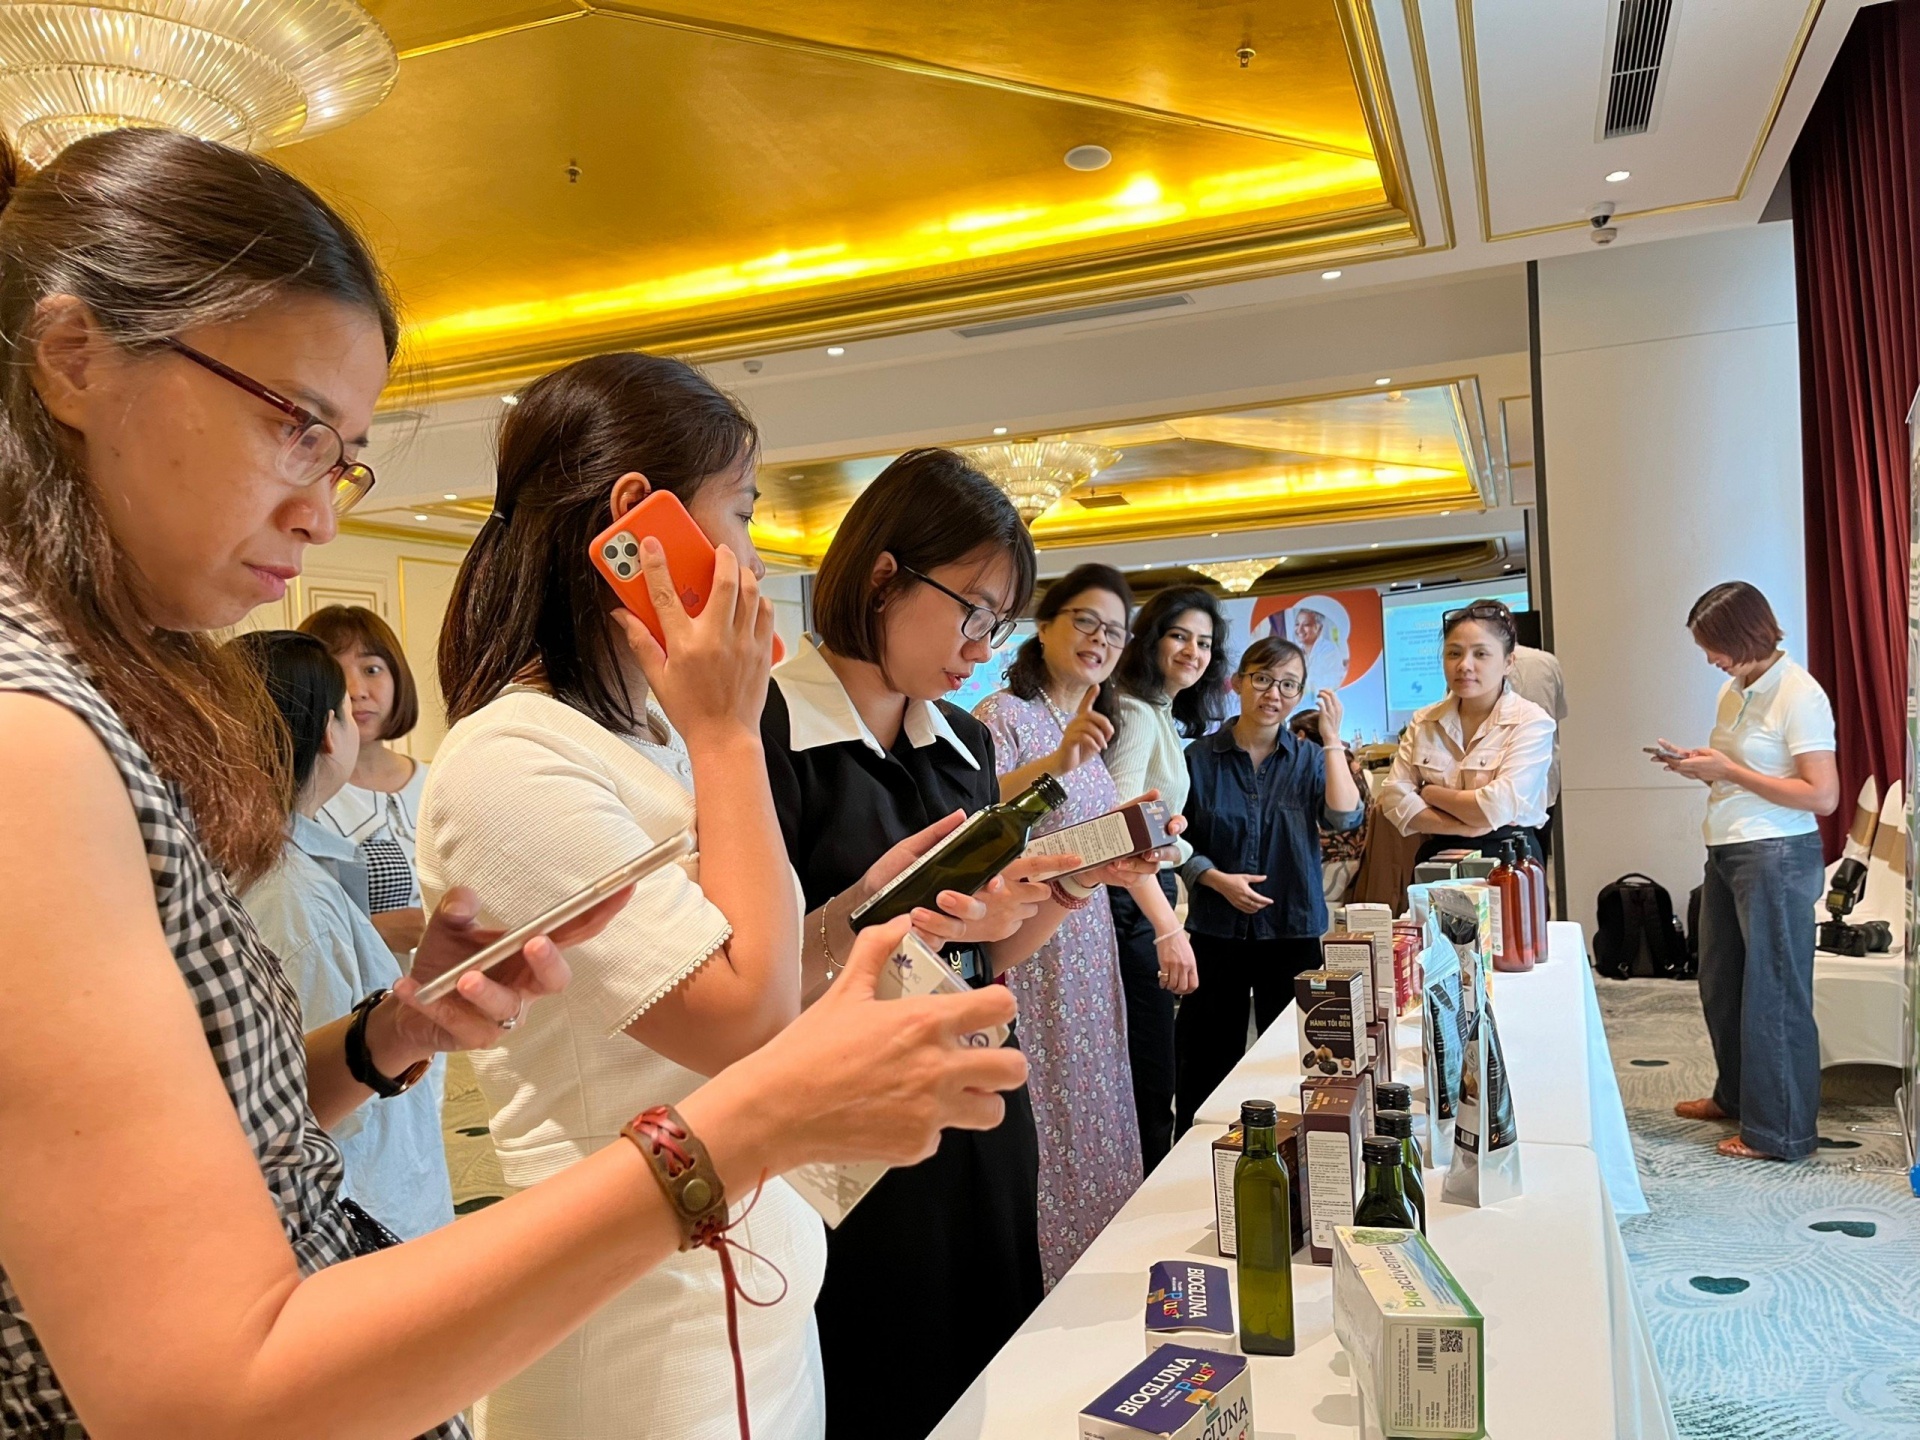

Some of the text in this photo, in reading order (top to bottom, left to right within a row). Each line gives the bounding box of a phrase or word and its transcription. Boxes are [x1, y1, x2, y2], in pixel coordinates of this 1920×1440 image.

[1187, 1266, 1208, 1319] BIOGLUNA
[1376, 1245, 1426, 1308] Bioactivemen
[1114, 1357, 1197, 1417] BIOGLUNA
[1196, 1396, 1249, 1440] GLUNA
